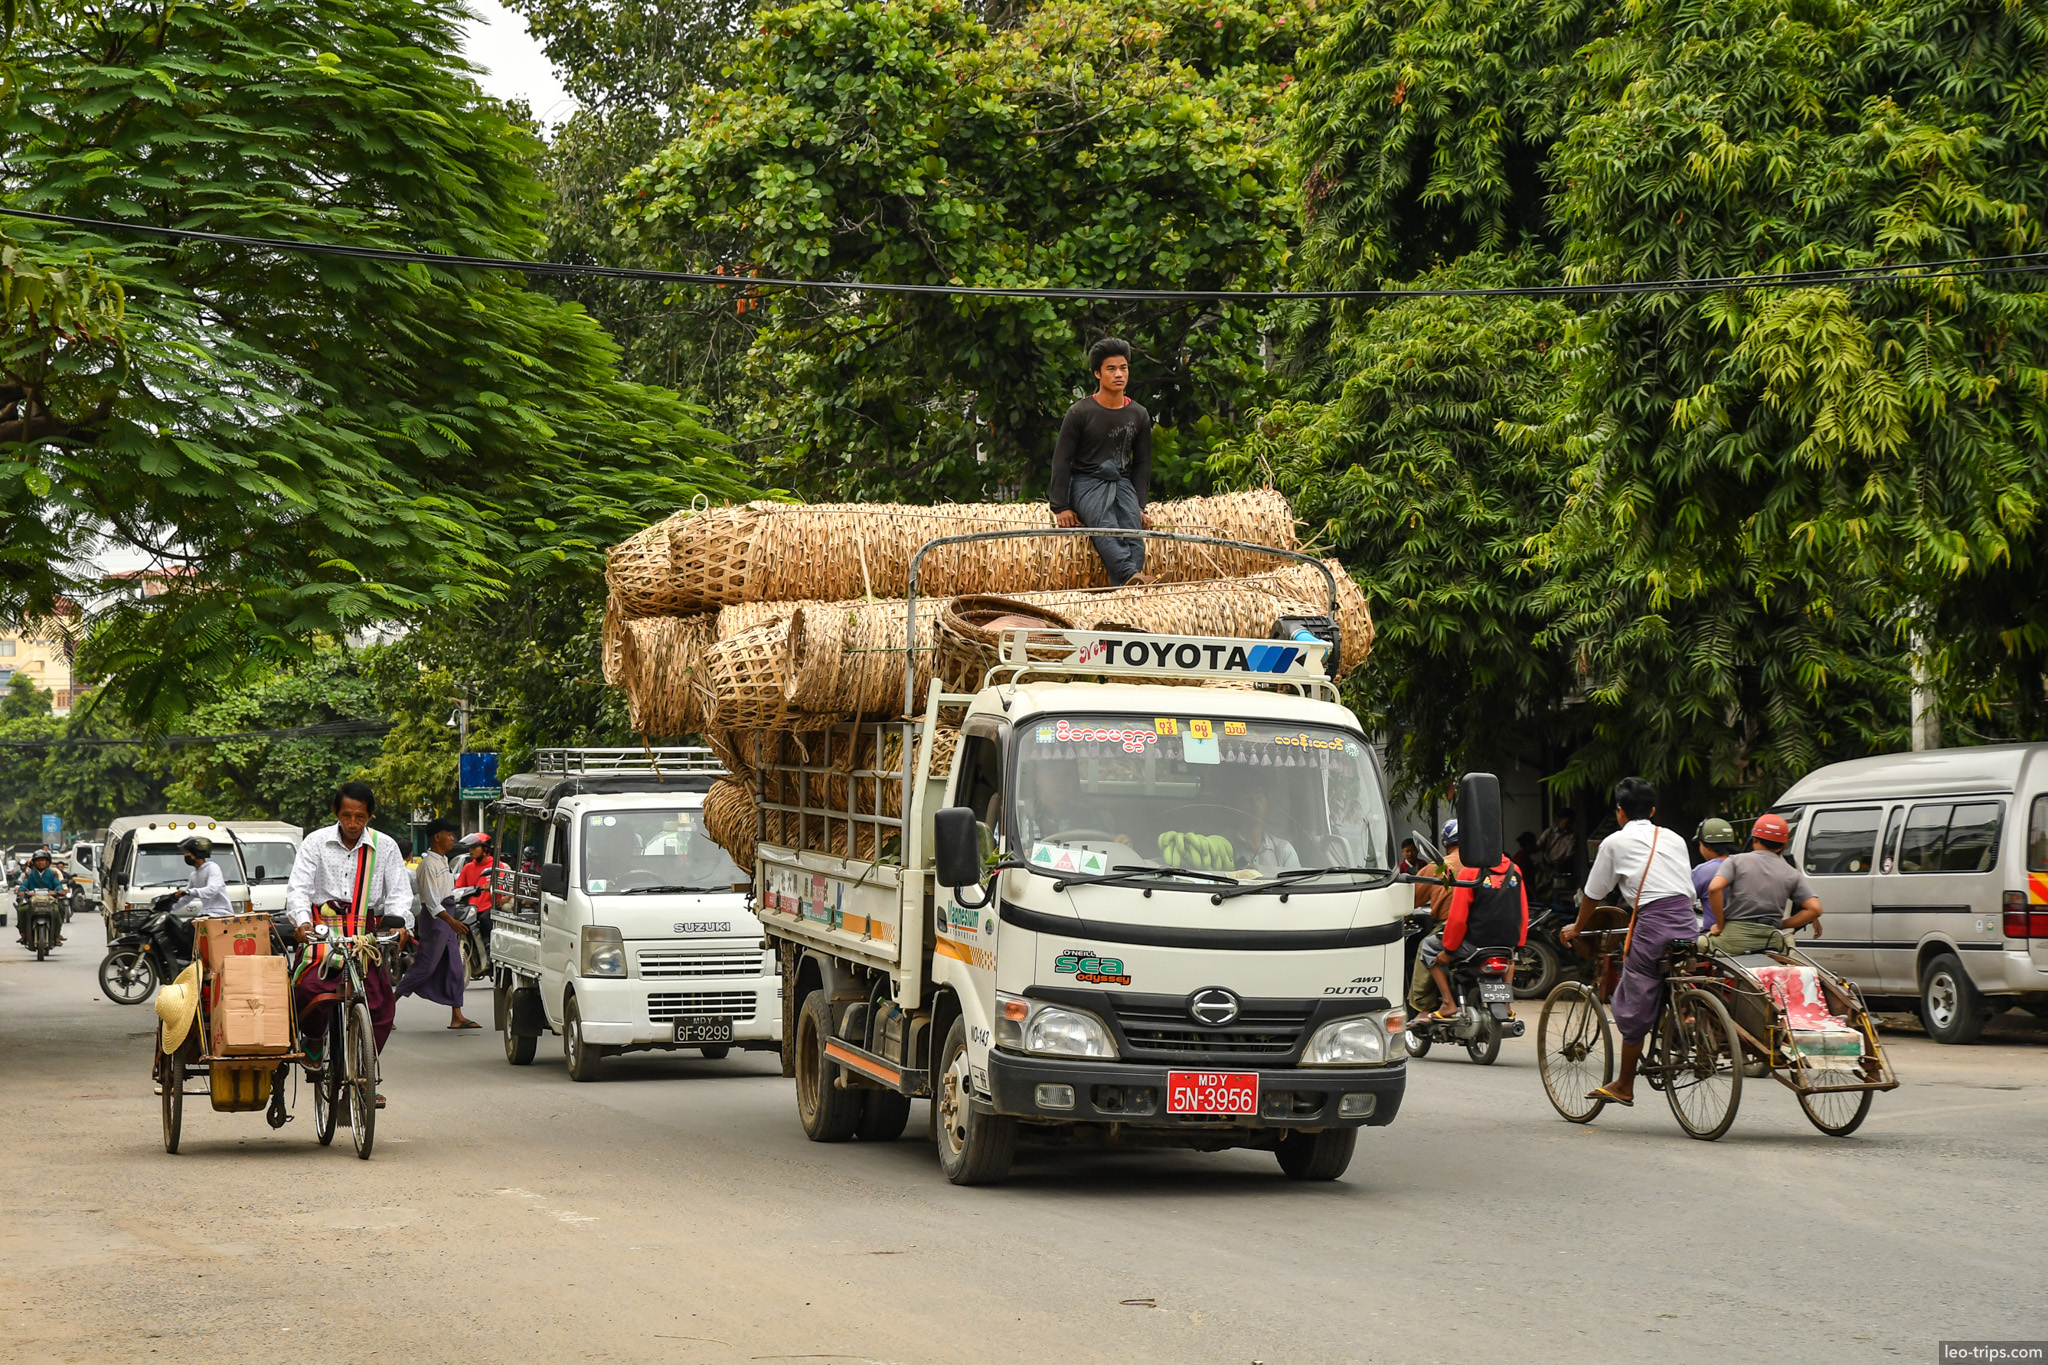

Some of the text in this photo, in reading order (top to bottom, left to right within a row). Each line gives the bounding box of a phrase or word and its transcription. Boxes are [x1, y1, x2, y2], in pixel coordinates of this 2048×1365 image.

[1098, 639, 1250, 671] TOYOTA
[947, 900, 979, 929] Magnesium
[673, 922, 731, 933] SUZUKI
[1076, 973, 1131, 985] odyssey
[1323, 986, 1378, 996] DUTRO
[677, 1025, 730, 1041] 6F-9299
[1198, 1074, 1228, 1087] MDY
[1173, 1087, 1253, 1111] 5N-3956
